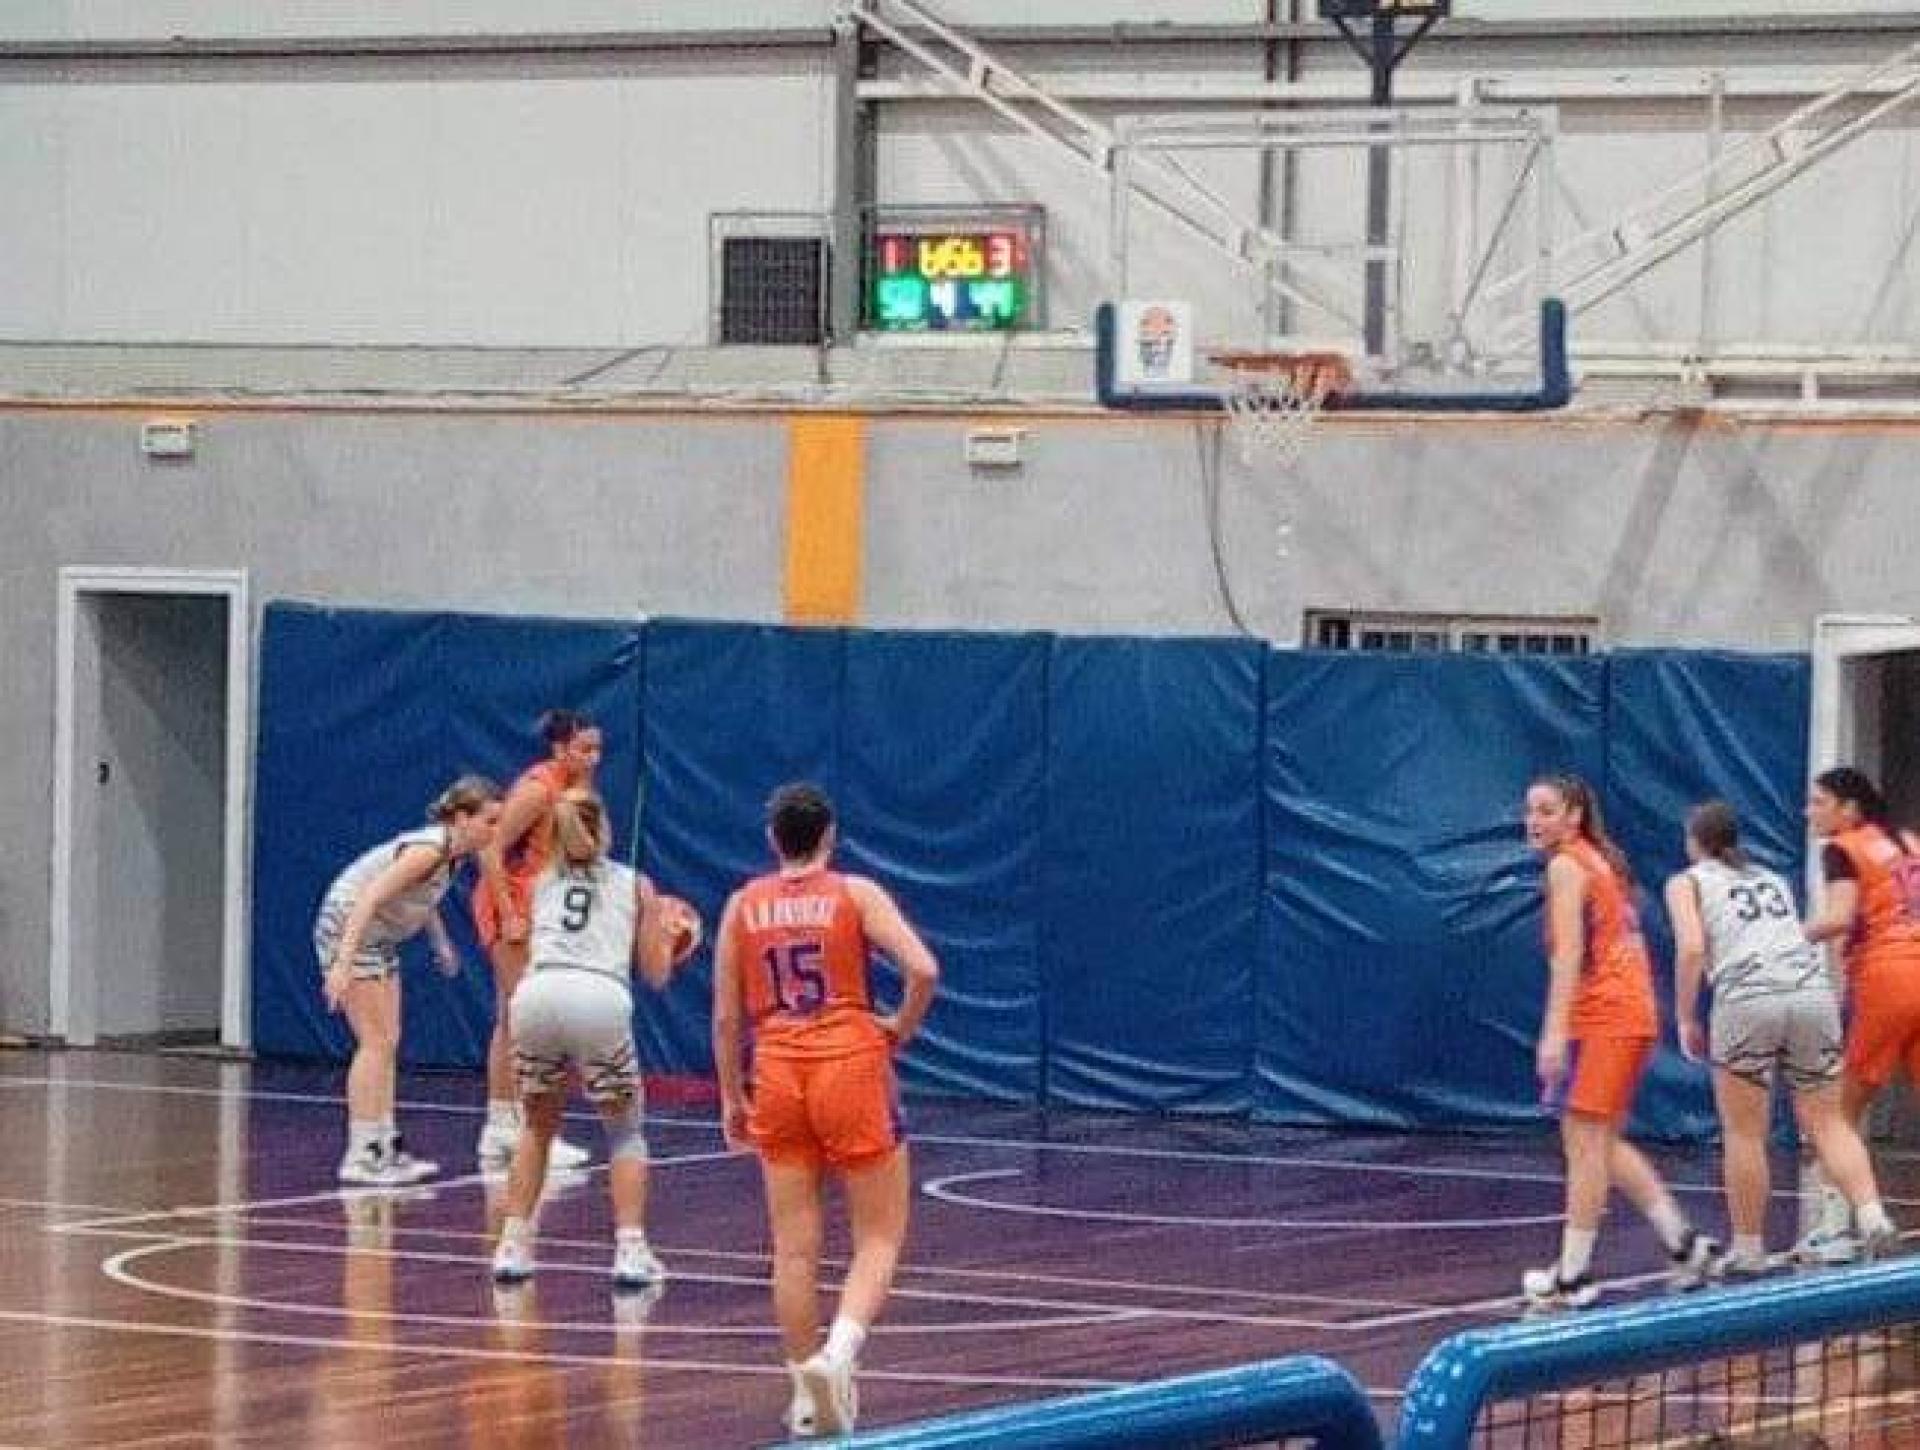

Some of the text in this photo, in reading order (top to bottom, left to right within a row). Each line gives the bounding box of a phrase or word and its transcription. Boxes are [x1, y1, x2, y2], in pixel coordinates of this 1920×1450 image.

[561, 886, 592, 933] 9
[1728, 882, 1788, 922] 33
[761, 941, 827, 1017] 15
